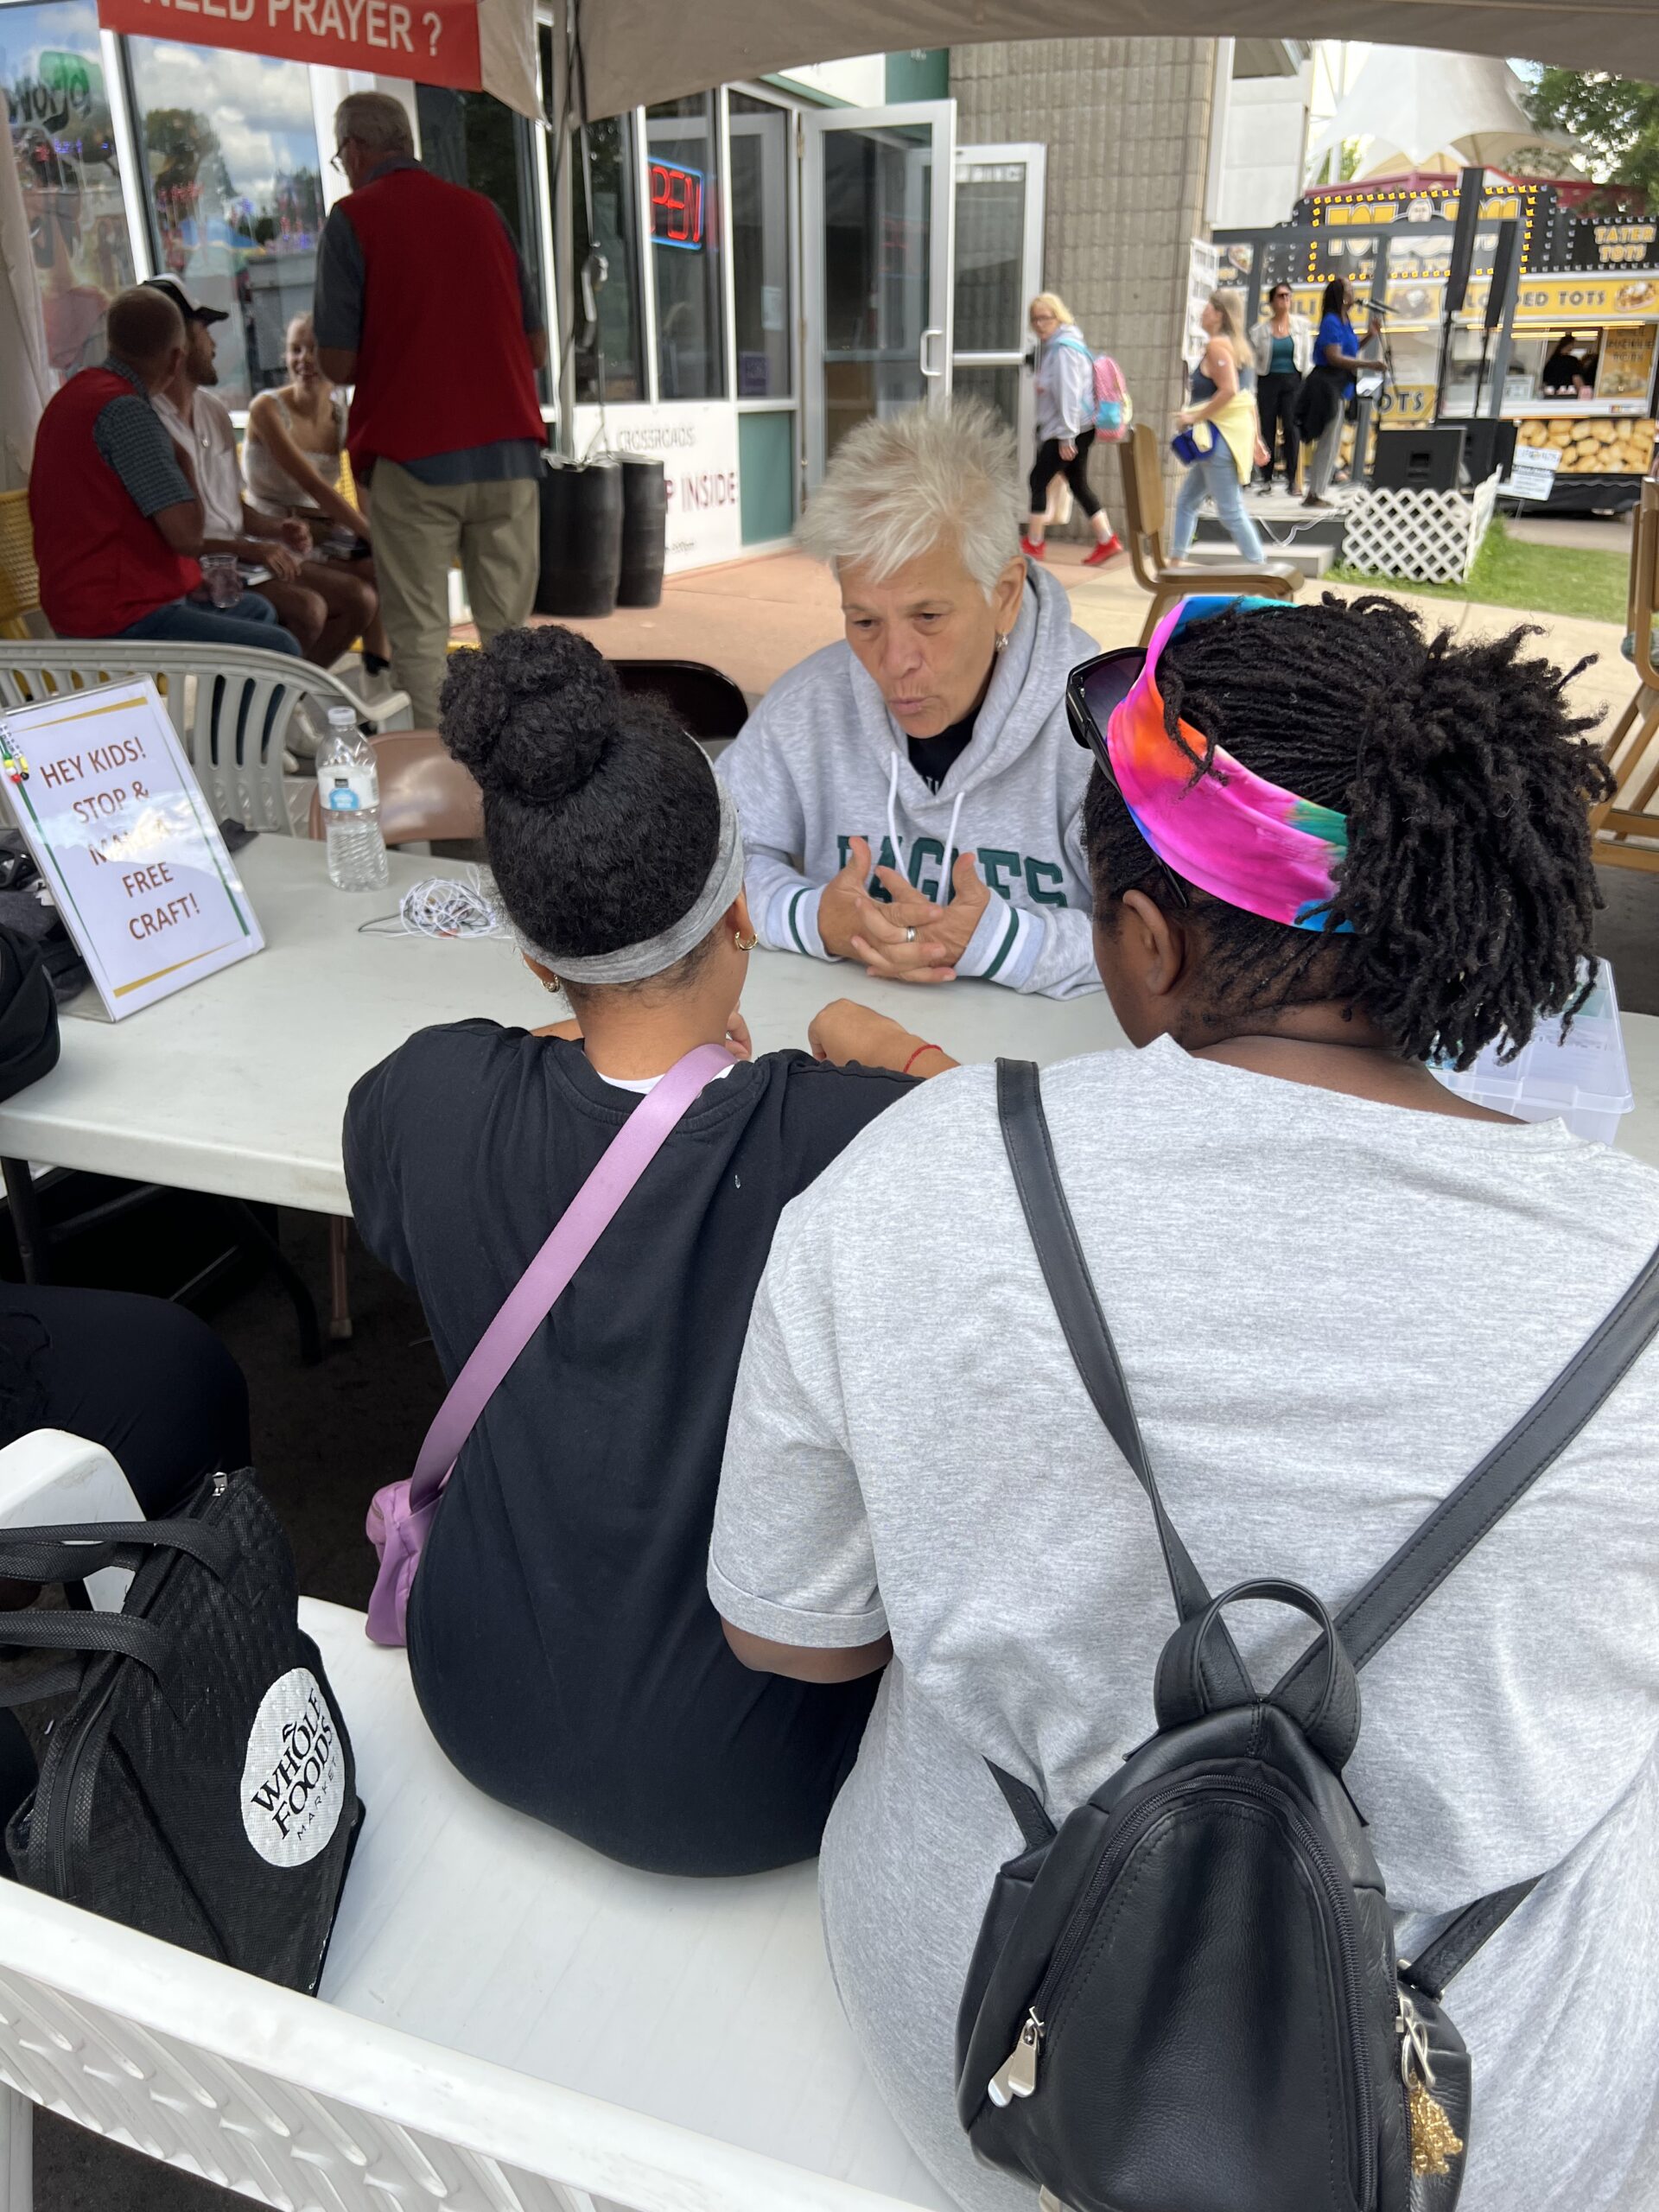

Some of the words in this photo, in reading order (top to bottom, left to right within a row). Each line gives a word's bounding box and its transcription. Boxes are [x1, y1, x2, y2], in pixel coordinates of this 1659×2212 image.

[268, 0, 415, 53] PRAYER
[422, 11, 442, 56] ?
[647, 165, 701, 243] PEN
[1594, 225, 1656, 245] TATER
[1599, 244, 1647, 263] TOTS
[1465, 290, 1549, 308] LOED
[1558, 289, 1606, 306] TOTS
[1372, 391, 1424, 414] OTS
[681, 472, 736, 512] INSIDE
[40, 755, 85, 789] HEY
[87, 736, 147, 774] KIDS!
[73, 788, 127, 823] STOP
[131, 780, 149, 799] &
[122, 861, 175, 898] FREE
[129, 893, 200, 940] CRAFT!
[251, 1688, 322, 1812] WHOLE
[272, 1716, 334, 1840] FOODS
[296, 1756, 338, 1840] MARKET
